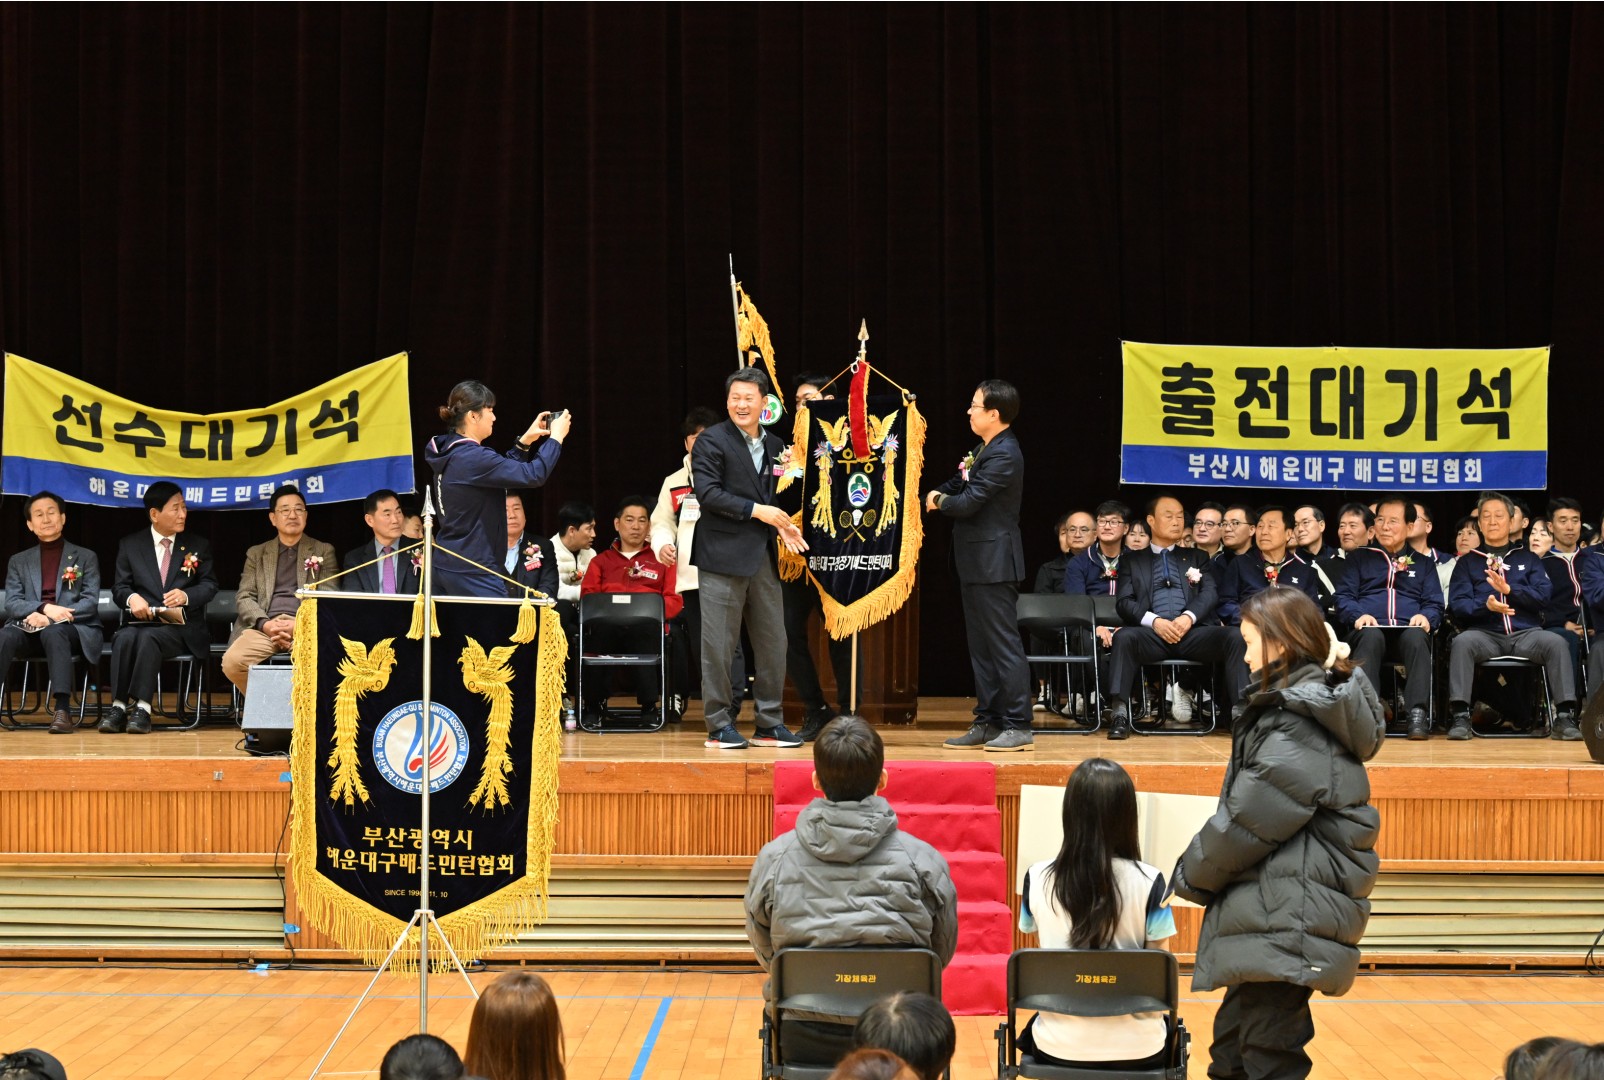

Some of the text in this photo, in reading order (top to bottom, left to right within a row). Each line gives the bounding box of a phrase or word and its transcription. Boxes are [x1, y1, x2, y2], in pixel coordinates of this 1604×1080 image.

[1160, 361, 1512, 442] 출전대기석
[52, 389, 361, 461] 선수대기석
[1187, 453, 1483, 484] 부산시 해운대구 배드민턴협회
[88, 474, 325, 504] 해운배드민턴회
[375, 703, 467, 752] BUSAN HAEUNDAE-GU BMINTON ASSOCIATION
[361, 826, 474, 851] 부산광역시
[834, 973, 877, 983] 기장체육관
[1075, 974, 1117, 984] 기장체육관
